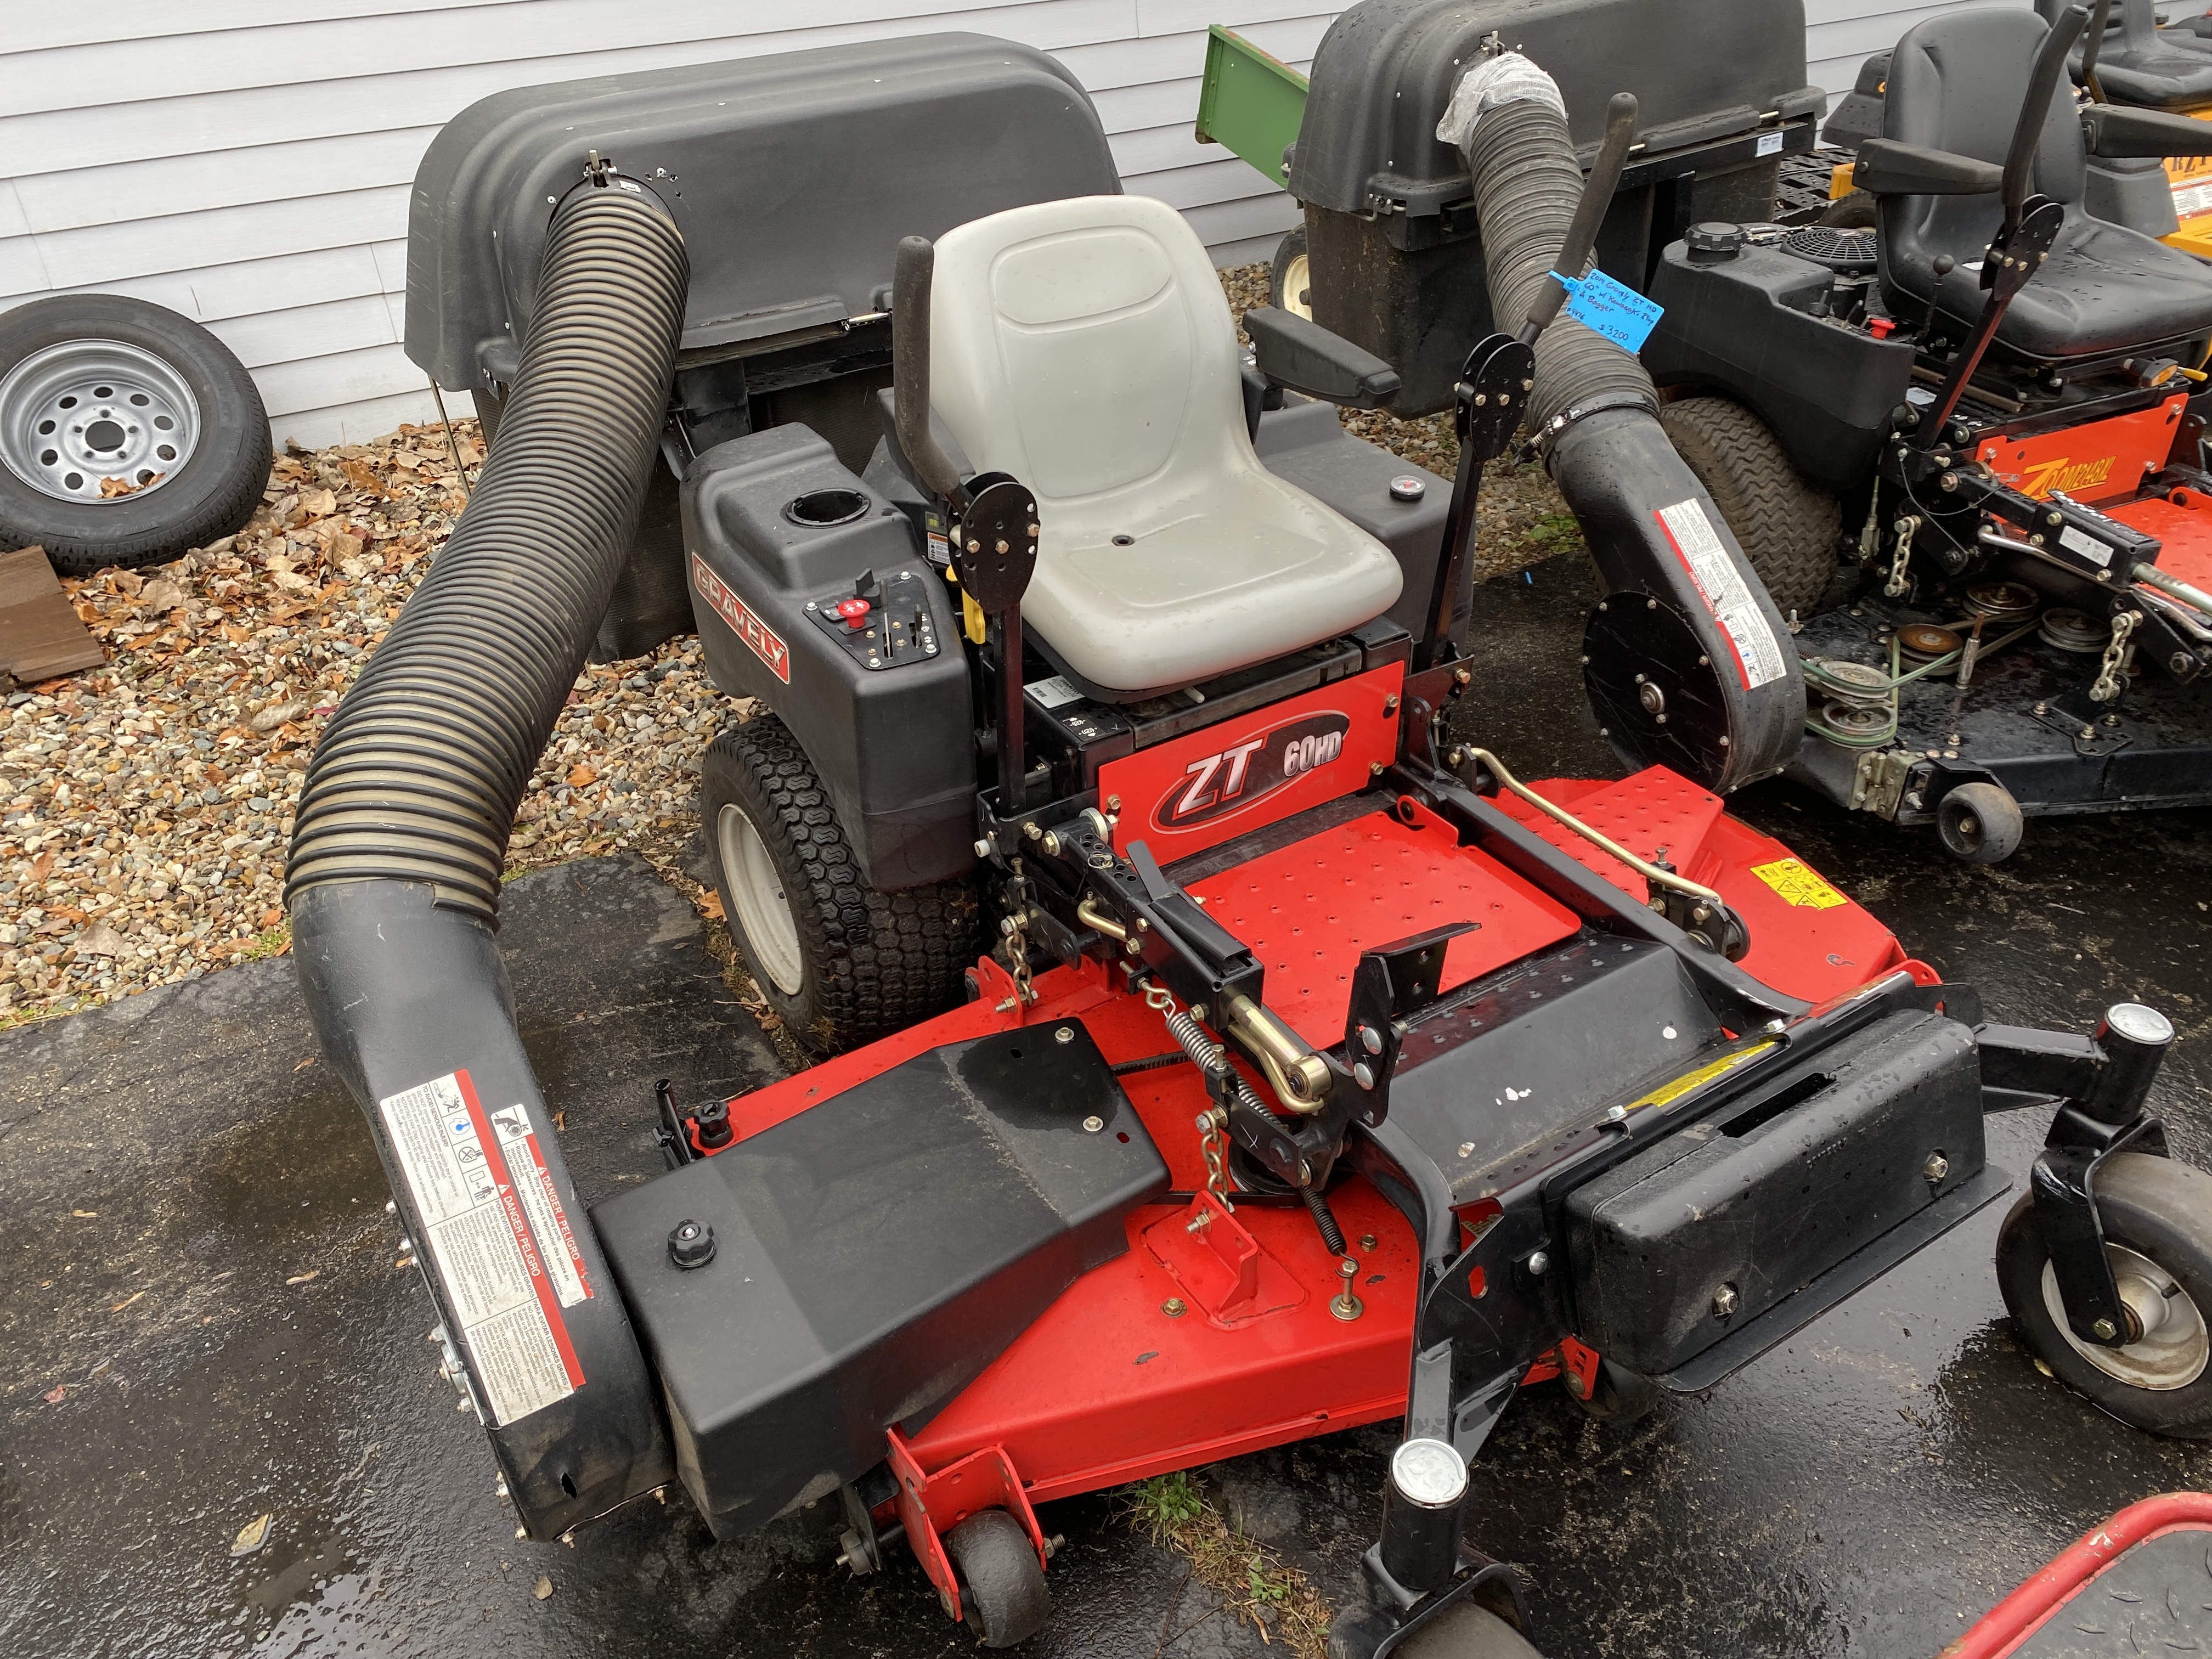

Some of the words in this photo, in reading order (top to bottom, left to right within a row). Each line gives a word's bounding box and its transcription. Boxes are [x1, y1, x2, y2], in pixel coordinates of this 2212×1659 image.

[1590, 272, 1605, 284] 2014
[1606, 282, 1629, 300] Gravely
[1633, 297, 1644, 305] ZT
[1646, 304, 1656, 312] HD
[695, 562, 786, 669] GRAVELY
[1689, 570, 1705, 593] PELIGRO
[1702, 594, 1717, 616] ANGER
[1178, 738, 1263, 814] ZT
[1284, 731, 1343, 777] 60HD
[424, 1092, 434, 1108] AVOID
[430, 1107, 442, 1130] SERIOUS
[438, 1129, 449, 1147] INJURY
[510, 1148, 524, 1178] mouvement.
[521, 1143, 531, 1158] Avoid
[526, 1158, 535, 1173] injury
[538, 1188, 546, 1200] clear
[545, 1207, 556, 1227] rotating
[552, 1227, 561, 1241] parts.
[494, 1200, 504, 1216] POUR
[500, 1215, 511, 1234] ÉVITER
[507, 1233, 515, 1245] LES
[511, 1244, 527, 1277] BLESSURES
[523, 1276, 535, 1298] GRAVES
[503, 1194, 524, 1233] DANGER
[519, 1237, 540, 1277] PELIGRO
[504, 1149, 514, 1164] Evitar
[510, 1165, 521, 1186] lesiones
[520, 1189, 534, 1218] Mantenerse
[531, 1218, 541, 1238] alejado
[544, 1254, 554, 1271] piezas
[550, 1271, 563, 1296] giratorias.
[515, 1145, 525, 1163] Risque
[524, 1170, 537, 1195] blessures
[556, 1256, 567, 1274] pièces
[541, 1175, 562, 1215] DANGER
[558, 1219, 580, 1260] PELIGRO
[532, 1299, 541, 1316] PARA
[538, 1315, 549, 1336] EVITAR
[545, 1335, 560, 1363] LESIONES
[556, 1363, 568, 1386] GRAVES
